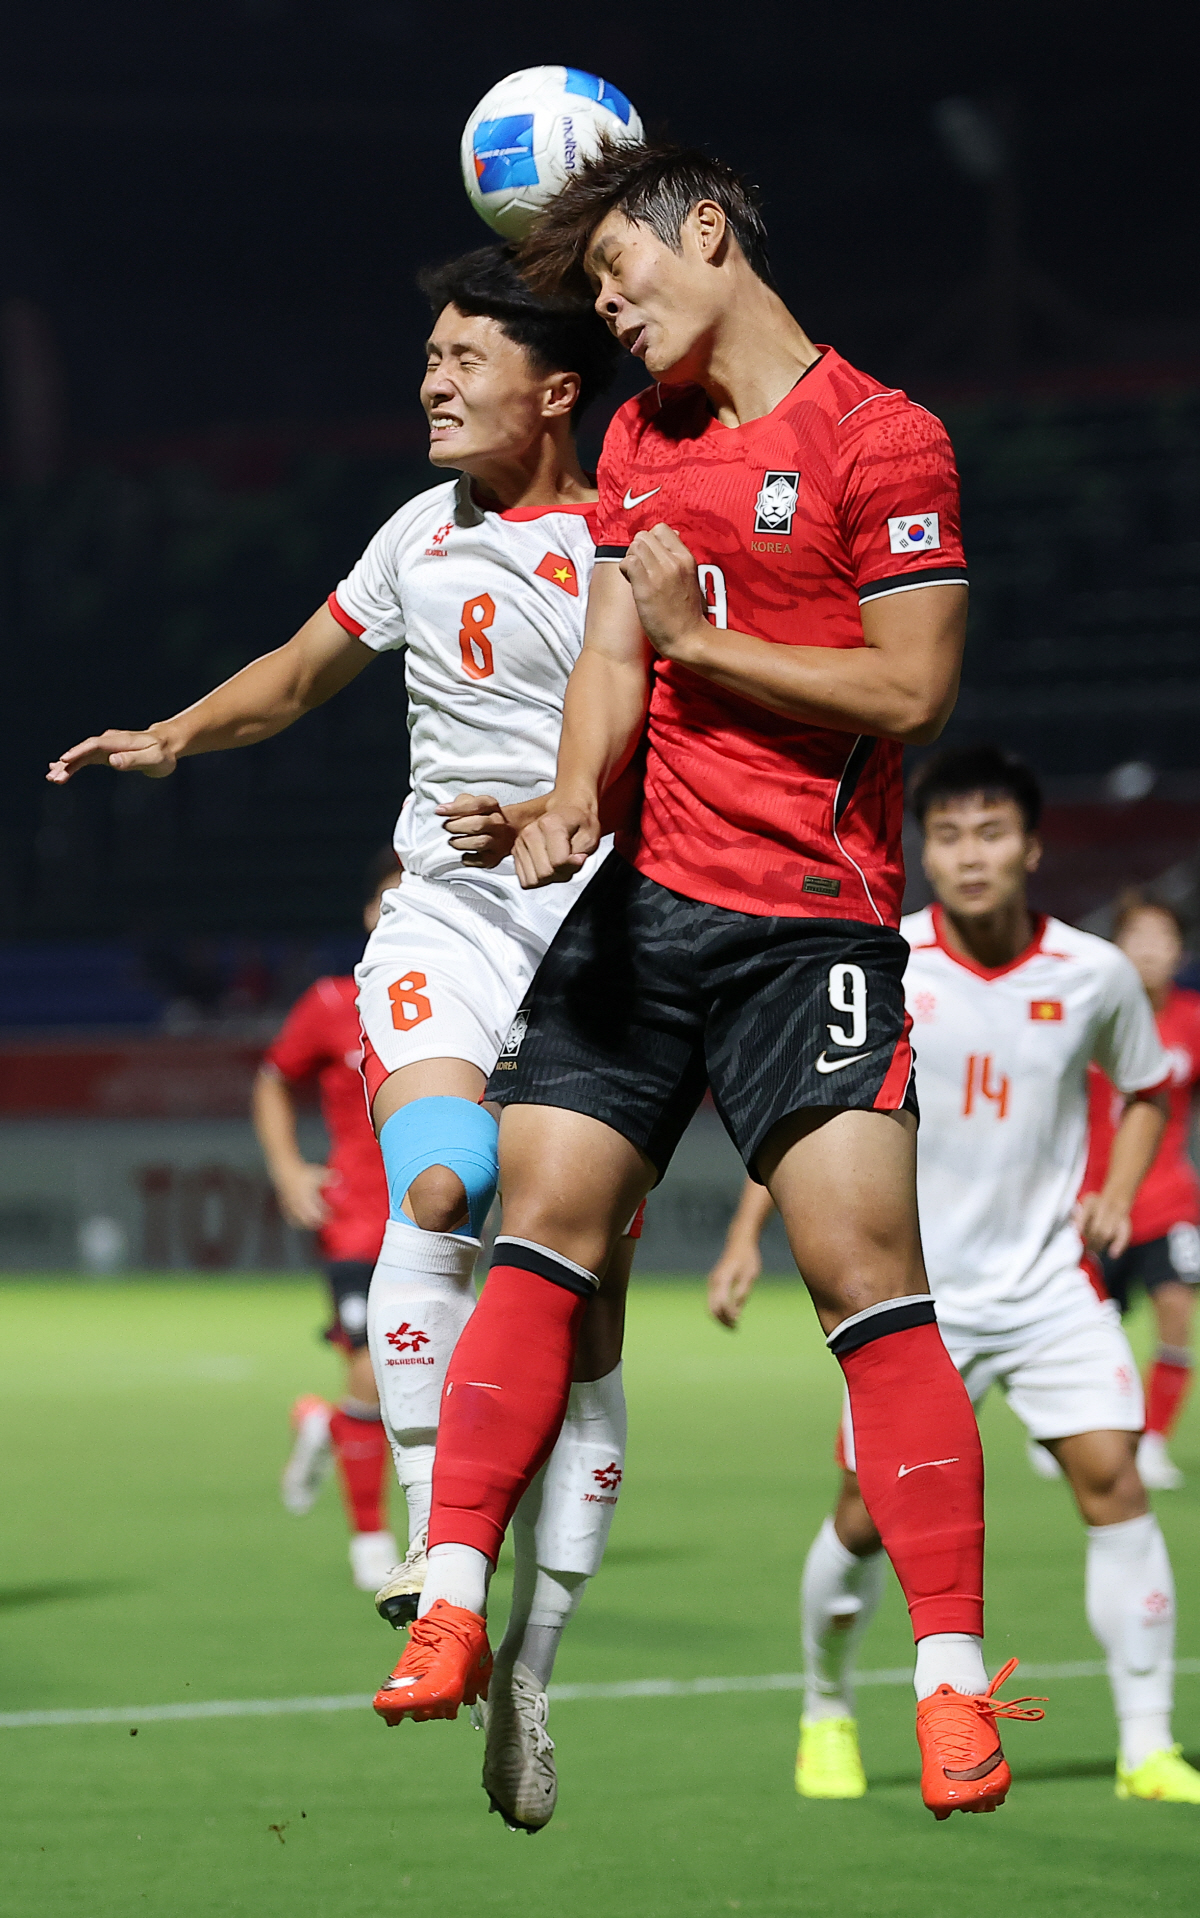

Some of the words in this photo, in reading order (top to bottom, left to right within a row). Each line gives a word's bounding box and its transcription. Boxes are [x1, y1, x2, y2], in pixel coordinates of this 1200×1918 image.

[562, 116, 578, 170] molten
[751, 540, 792, 554] KOREA
[459, 592, 496, 680] 8
[388, 970, 433, 1032] 8
[827, 963, 868, 1048] 9
[962, 1054, 1011, 1119] 14
